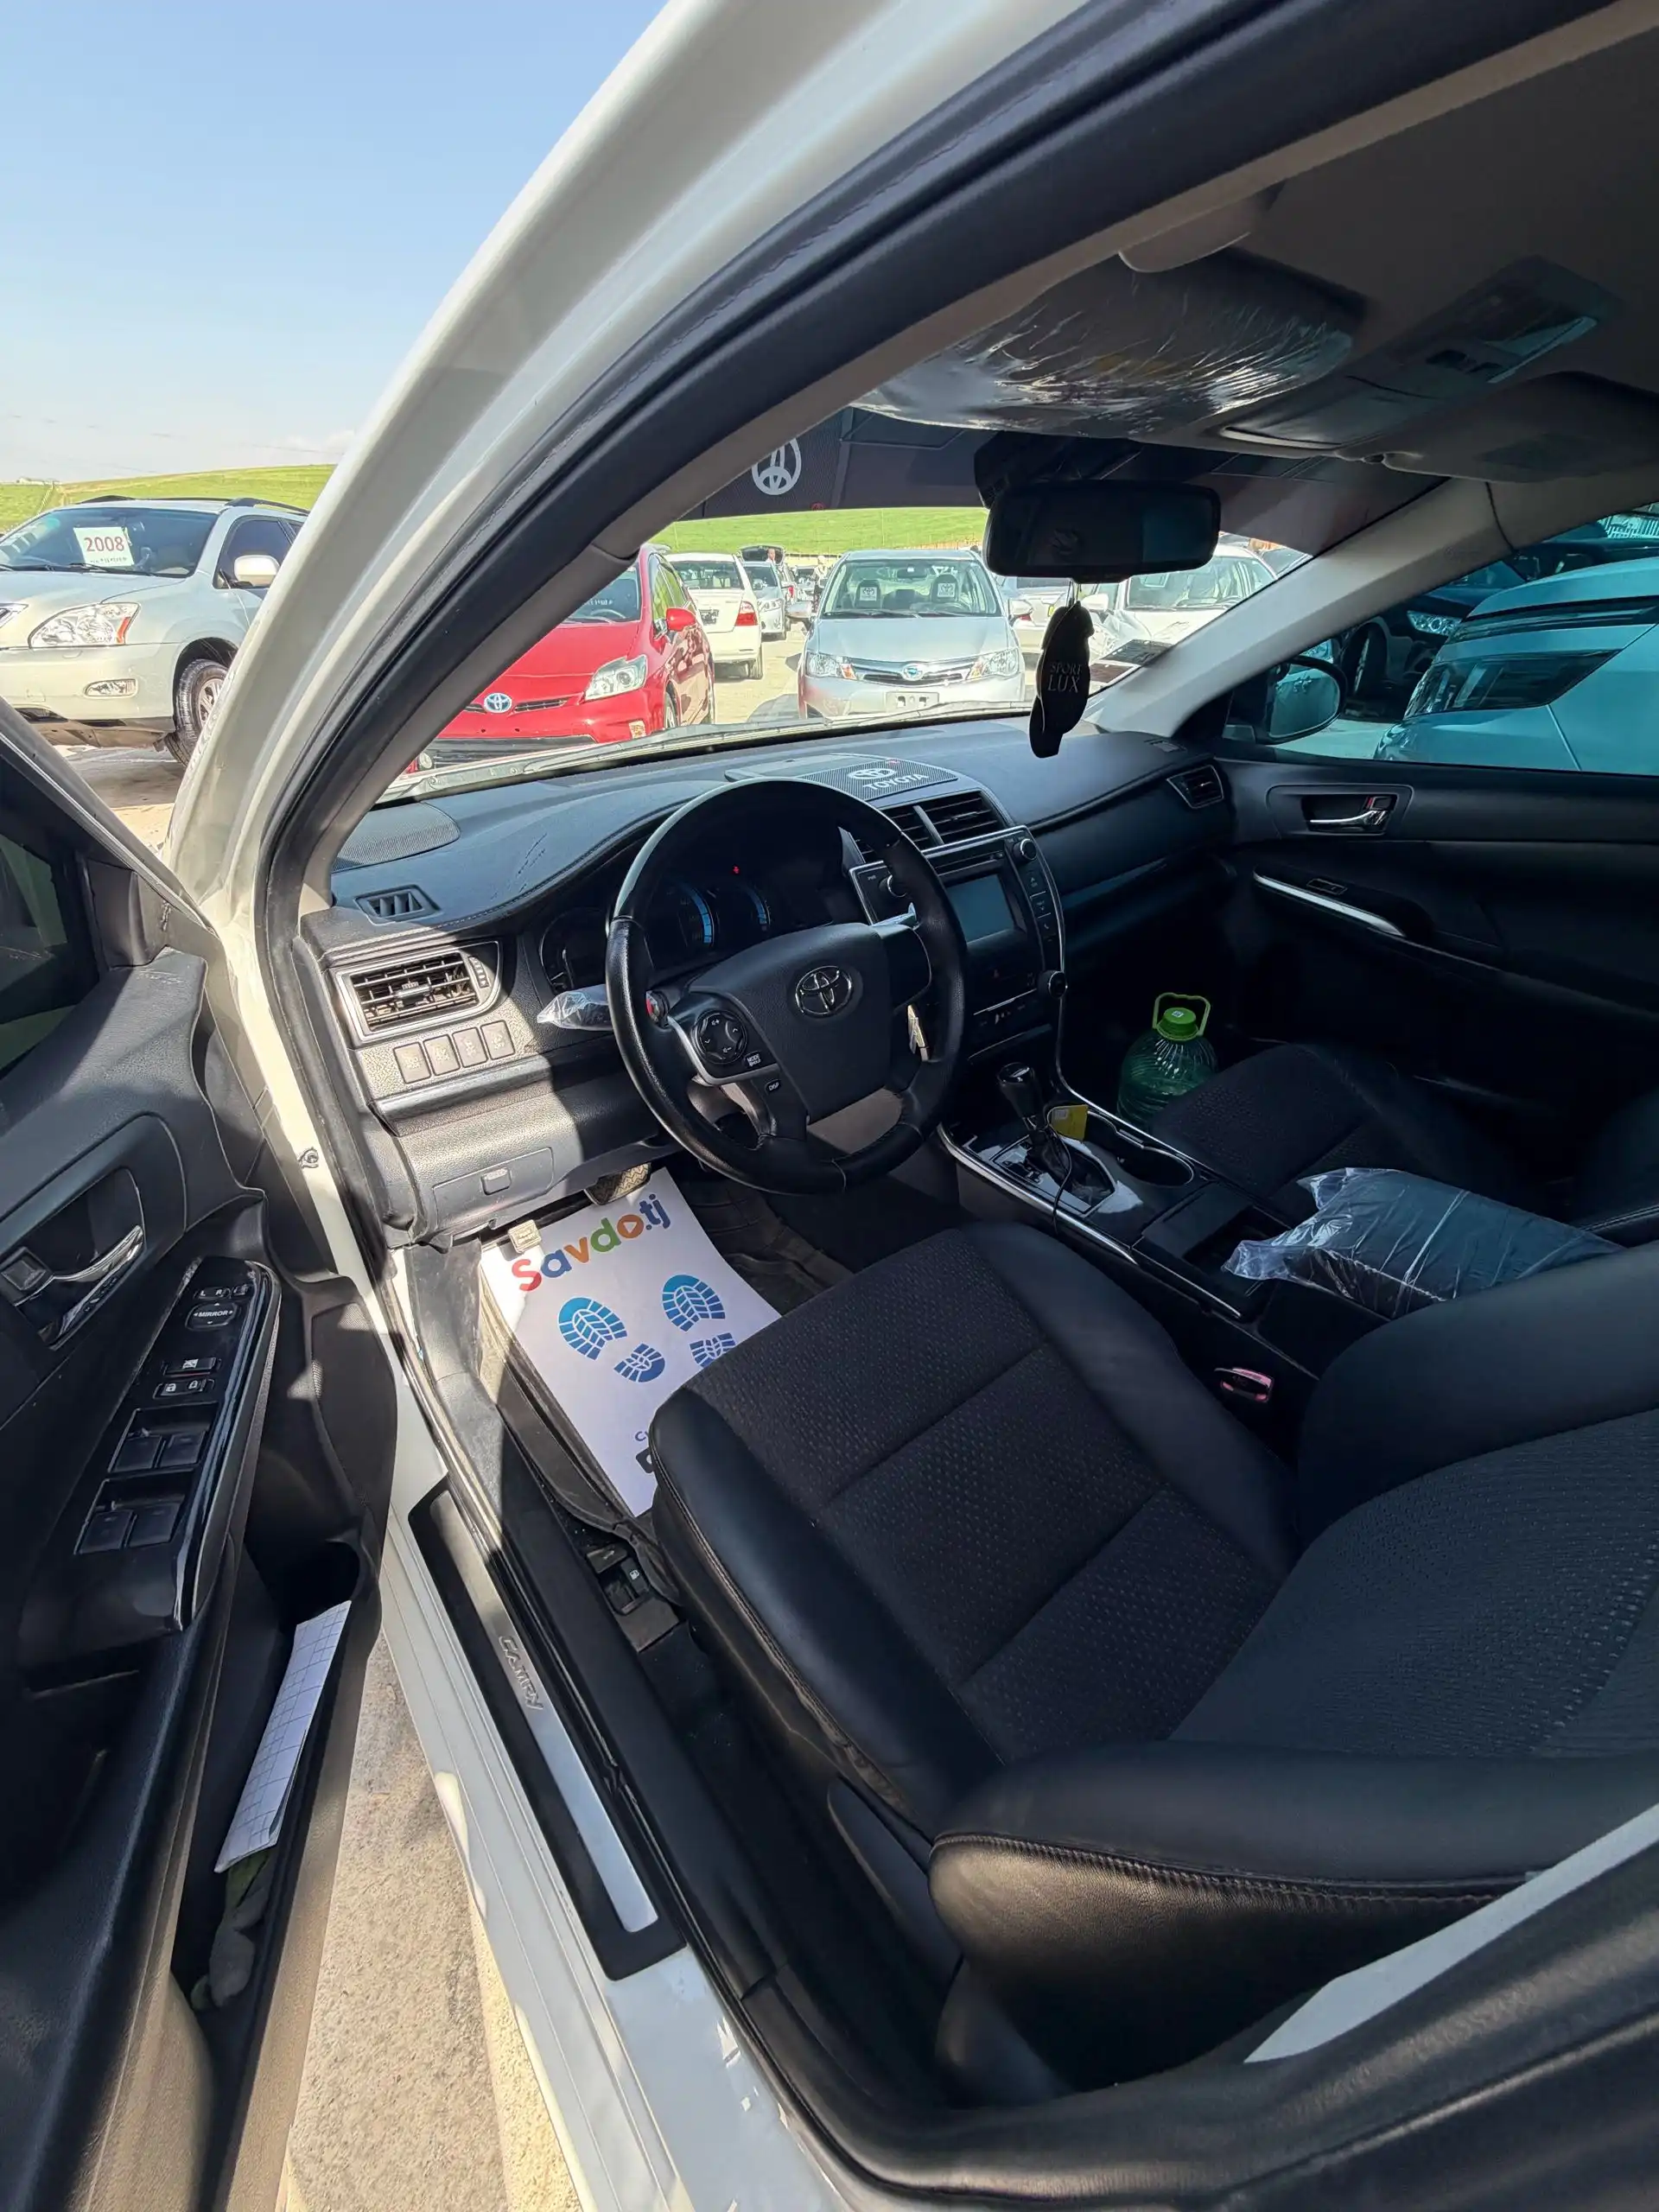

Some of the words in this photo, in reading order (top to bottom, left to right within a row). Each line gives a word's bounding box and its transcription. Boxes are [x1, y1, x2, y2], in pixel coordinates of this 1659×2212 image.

[84, 536, 124, 552] 2008
[1050, 663, 1081, 675] SPORT
[1047, 674, 1079, 693] LUX
[862, 774, 929, 790] TOYOTA
[512, 1194, 671, 1292] Savdo.tj
[499, 1636, 543, 1710] CAMRY
